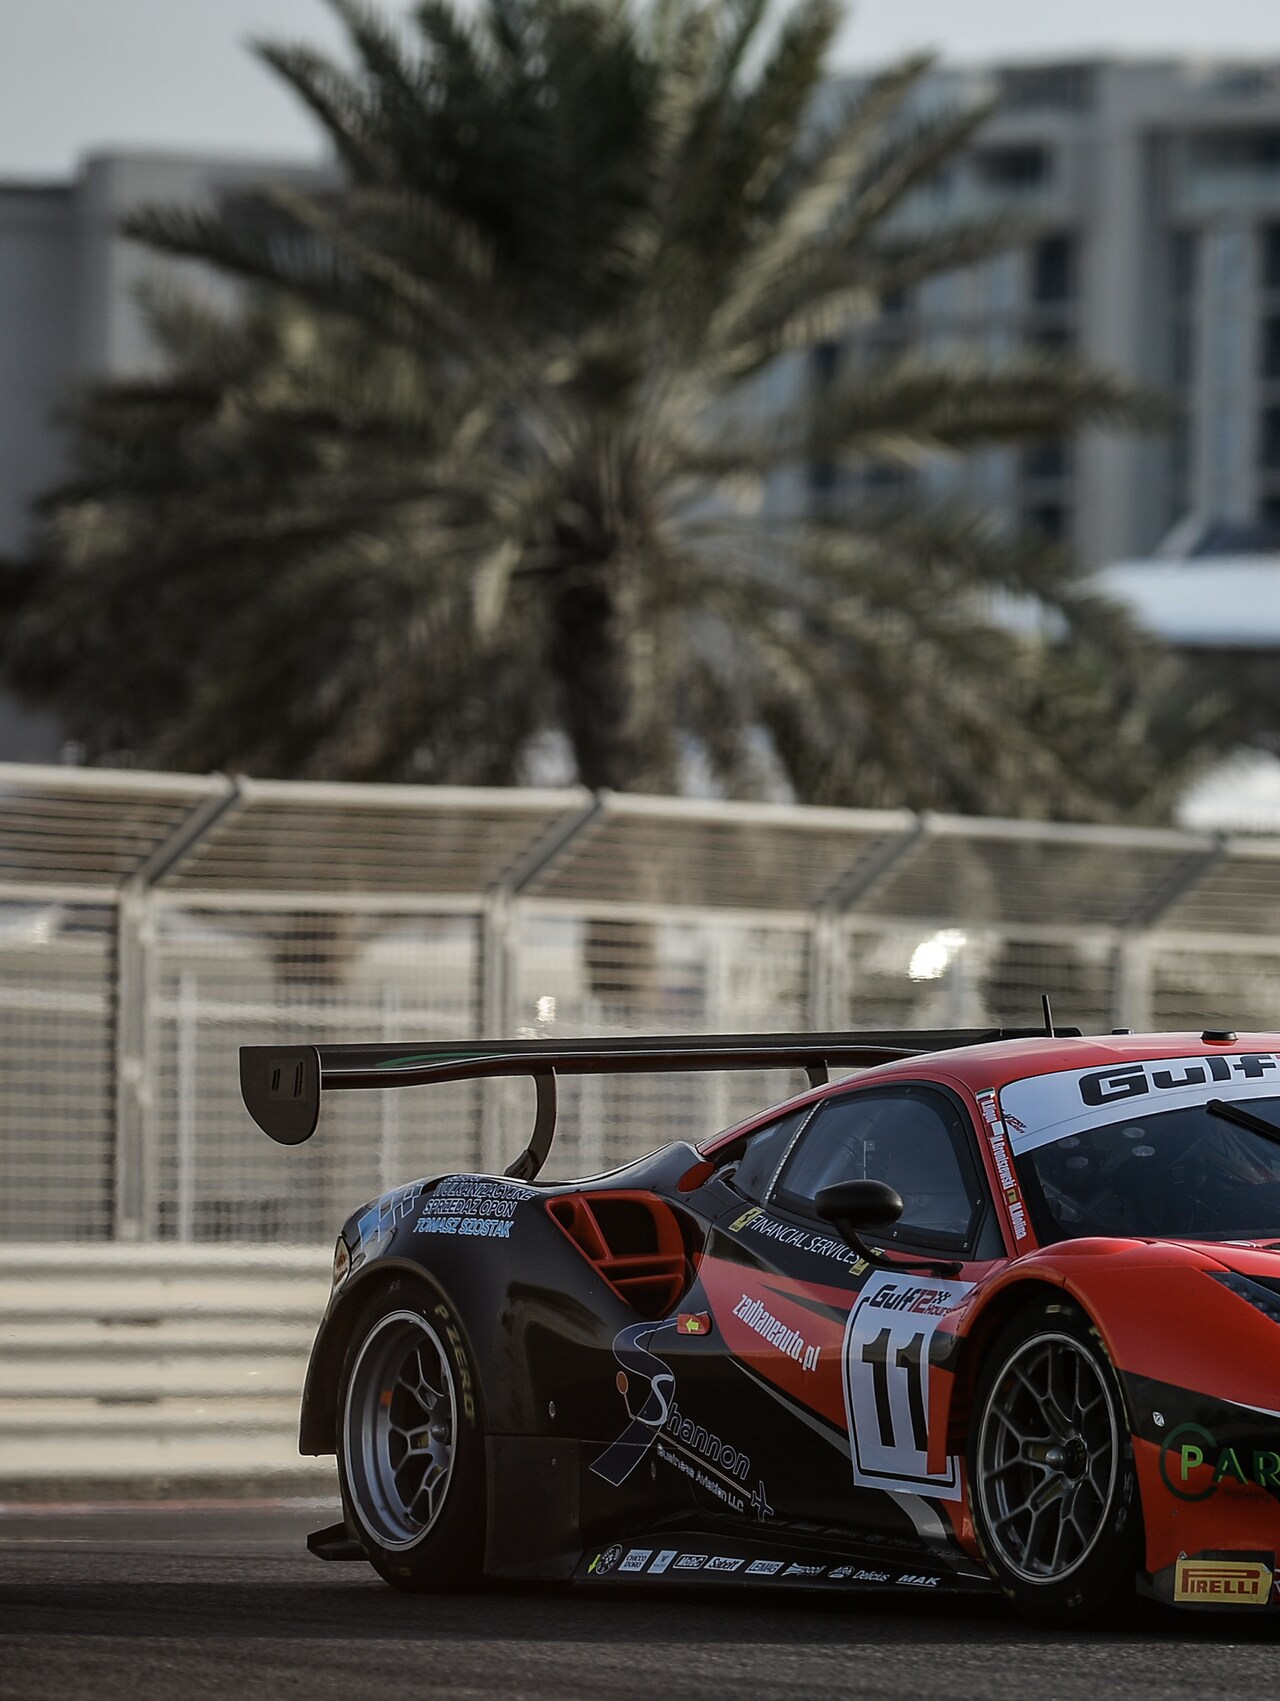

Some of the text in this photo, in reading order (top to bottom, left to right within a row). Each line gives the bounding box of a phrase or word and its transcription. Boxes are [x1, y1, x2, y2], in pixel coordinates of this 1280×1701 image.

[1079, 1055, 1276, 1106] Gulf
[413, 1217, 514, 1238] TOMASZ SZOSTAK
[479, 1200, 518, 1217] OPON
[746, 1215, 860, 1265] FINANCIAL SERVICES
[732, 1293, 821, 1372] zadbaneauto.pl
[862, 1327, 928, 1453] 11
[637, 1373, 751, 1480] Shannon
[898, 1574, 941, 1586] MAK
[1181, 1568, 1260, 1595] PIRELLI
